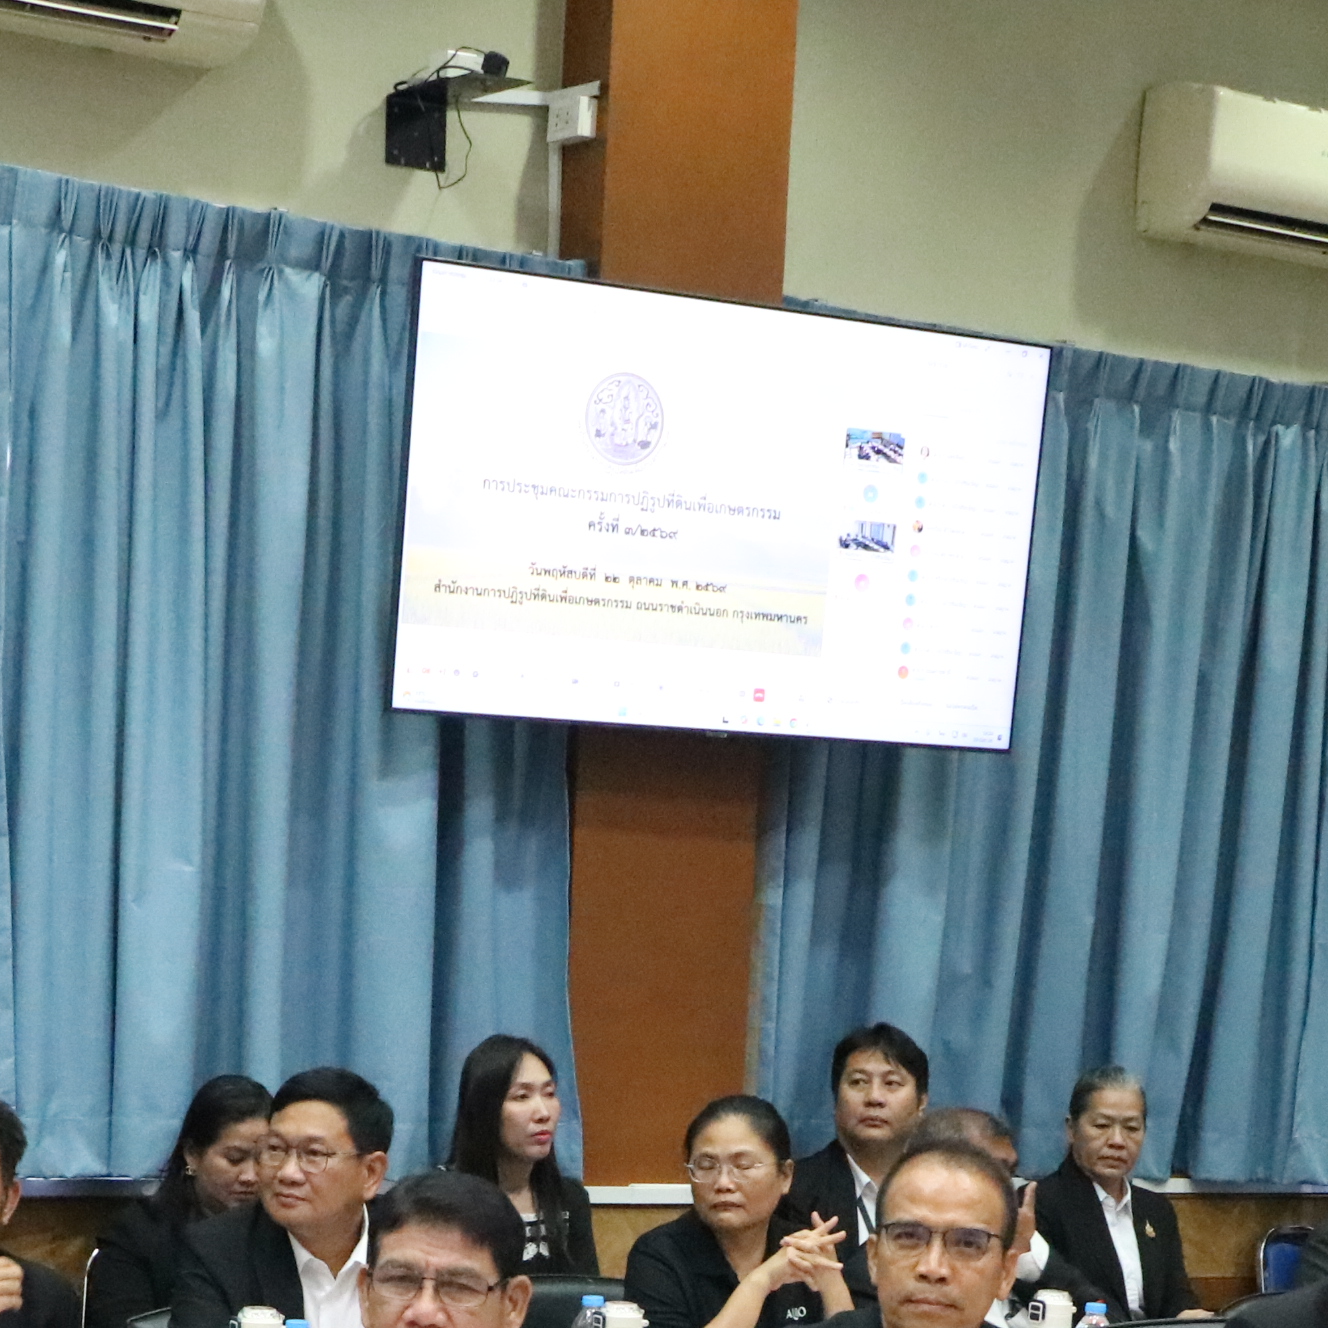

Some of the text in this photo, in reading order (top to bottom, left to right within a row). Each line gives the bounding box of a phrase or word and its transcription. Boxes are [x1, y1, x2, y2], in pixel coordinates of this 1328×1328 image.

[482, 477, 780, 521] การประชุมคณะกรรมการปฏิรูปที่ดินเพื่อเกษตรกรรม
[588, 511, 620, 534] ครั้งที่
[528, 562, 596, 582] วันพฤหัสบดีที่
[628, 575, 663, 589] ตุลาคม
[434, 578, 808, 626] สำนักงานการปฏิรูปที่ดินเพื่อเกษตรกรรม ถนนราชดำเนินนอก กรุงเทพมหานคร
